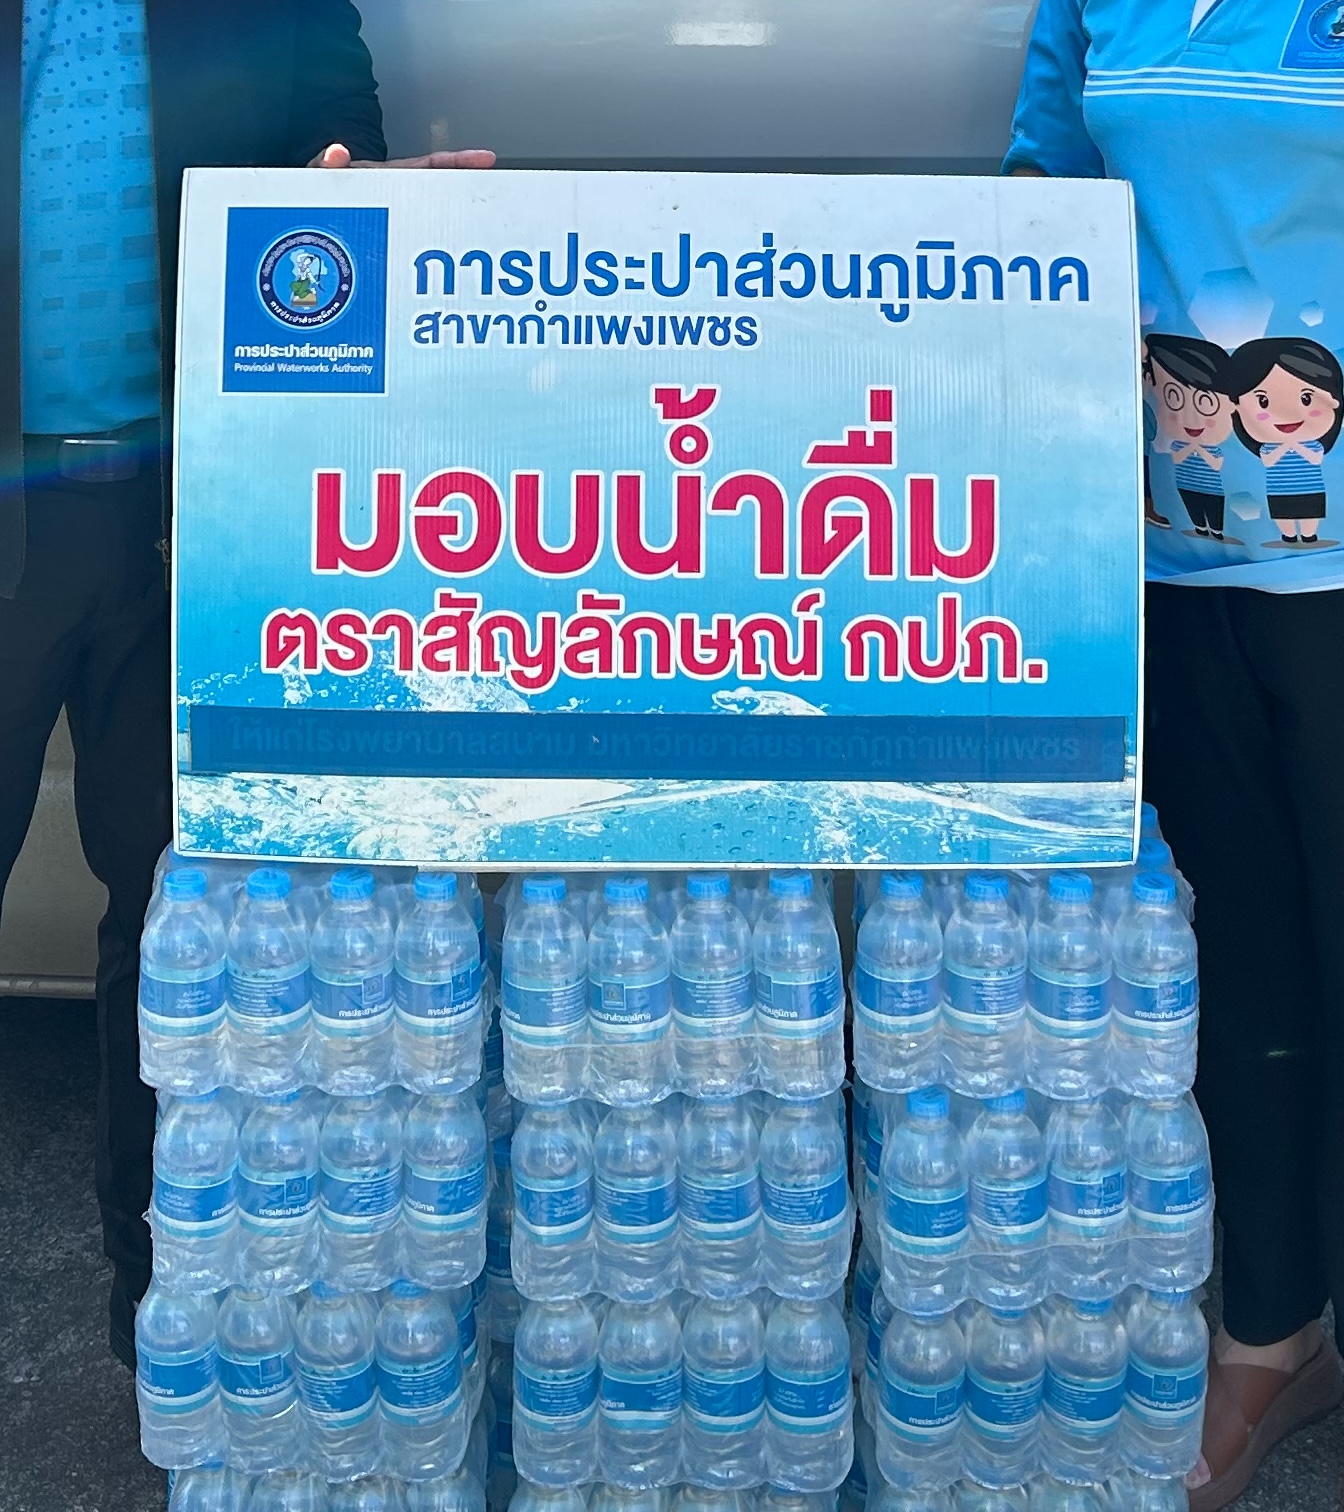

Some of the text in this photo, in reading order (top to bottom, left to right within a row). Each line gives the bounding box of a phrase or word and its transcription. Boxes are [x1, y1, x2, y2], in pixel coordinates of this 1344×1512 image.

[413, 232, 1089, 323] การประปาส่วนภูมิภาค
[234, 343, 374, 361] การประปาส่วนภูมิภาค
[413, 299, 758, 347] สาขากำแพงเพชร
[234, 362, 373, 375] Provincial Waterworks Authority
[315, 387, 997, 579] มอบน้ำดื่ม
[264, 592, 1045, 687] ตราสัญลักษณ์ กปภ.
